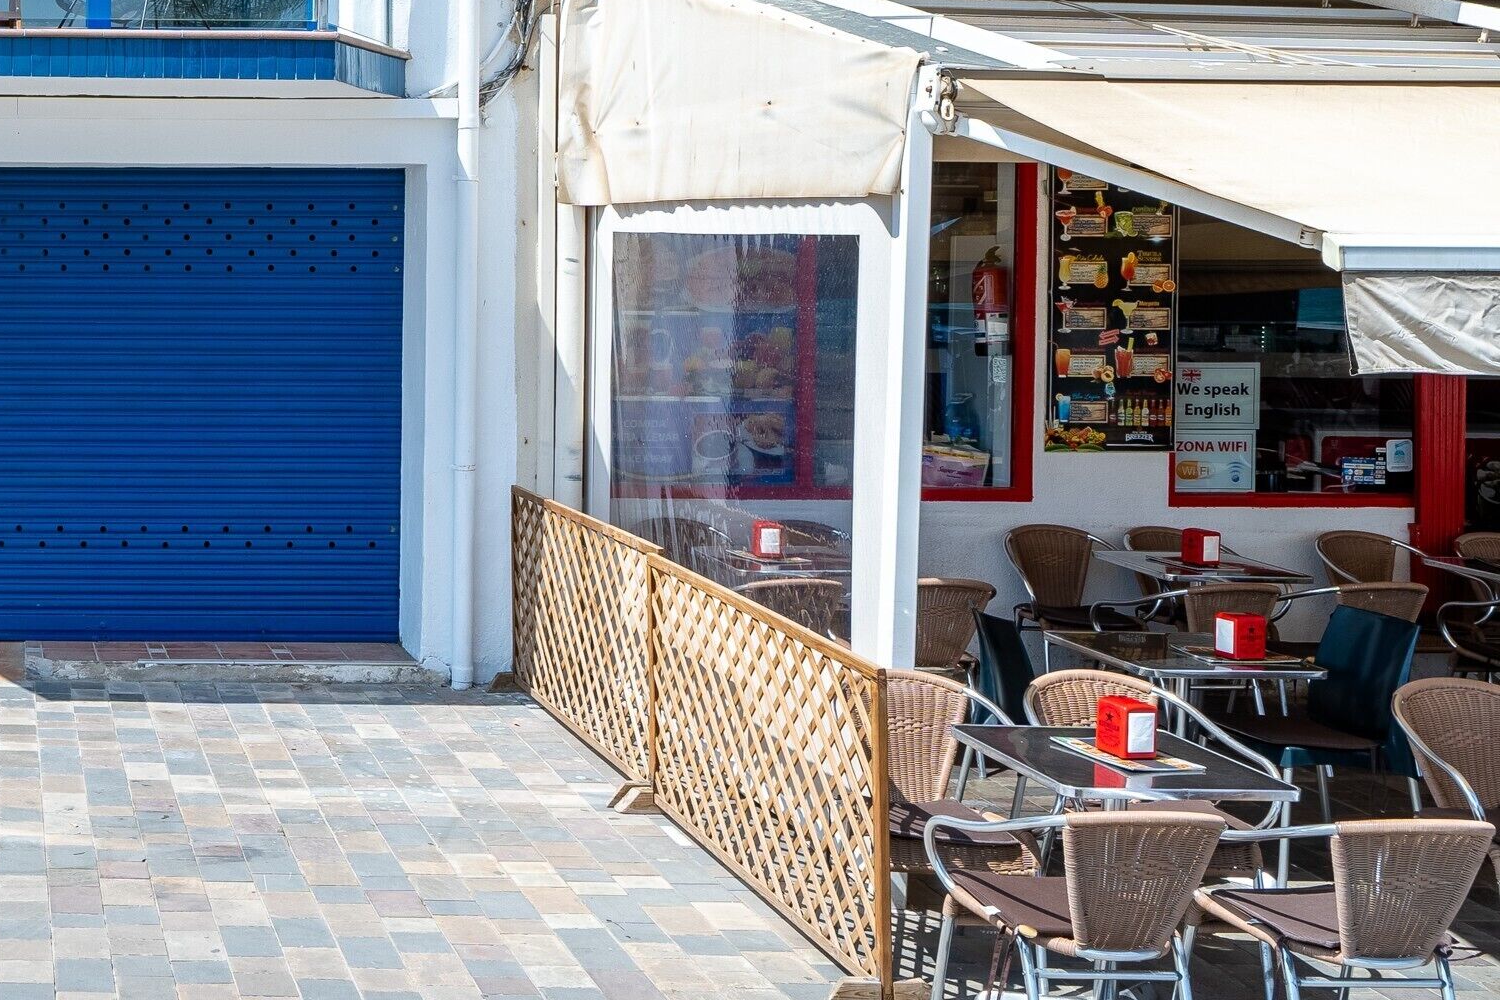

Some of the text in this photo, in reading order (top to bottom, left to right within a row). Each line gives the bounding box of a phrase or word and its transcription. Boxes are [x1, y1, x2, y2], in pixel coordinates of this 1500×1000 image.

[1177, 383, 1249, 398] We speak
[1184, 403, 1240, 419] English
[1125, 433, 1154, 442] BREEZER
[1176, 441, 1247, 452] ZONA WIFI
